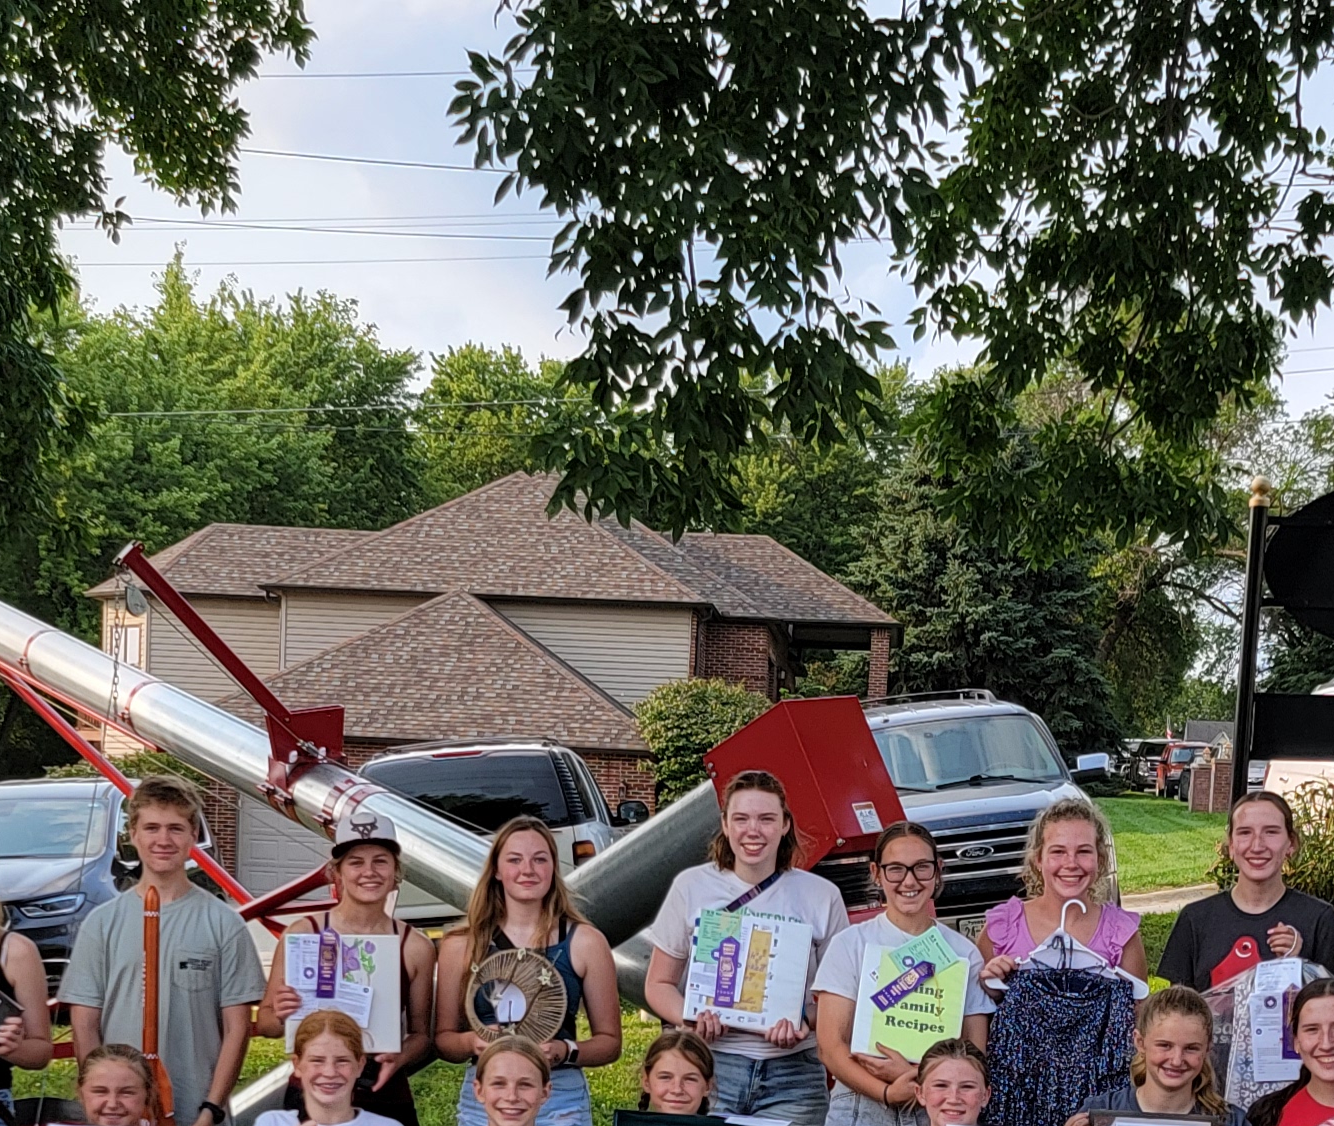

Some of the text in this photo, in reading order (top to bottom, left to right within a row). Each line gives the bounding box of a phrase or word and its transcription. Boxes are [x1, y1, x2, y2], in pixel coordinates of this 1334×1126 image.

[965, 847, 985, 857] Ford
[914, 984, 944, 999] ing
[885, 1015, 945, 1033] Recipes
